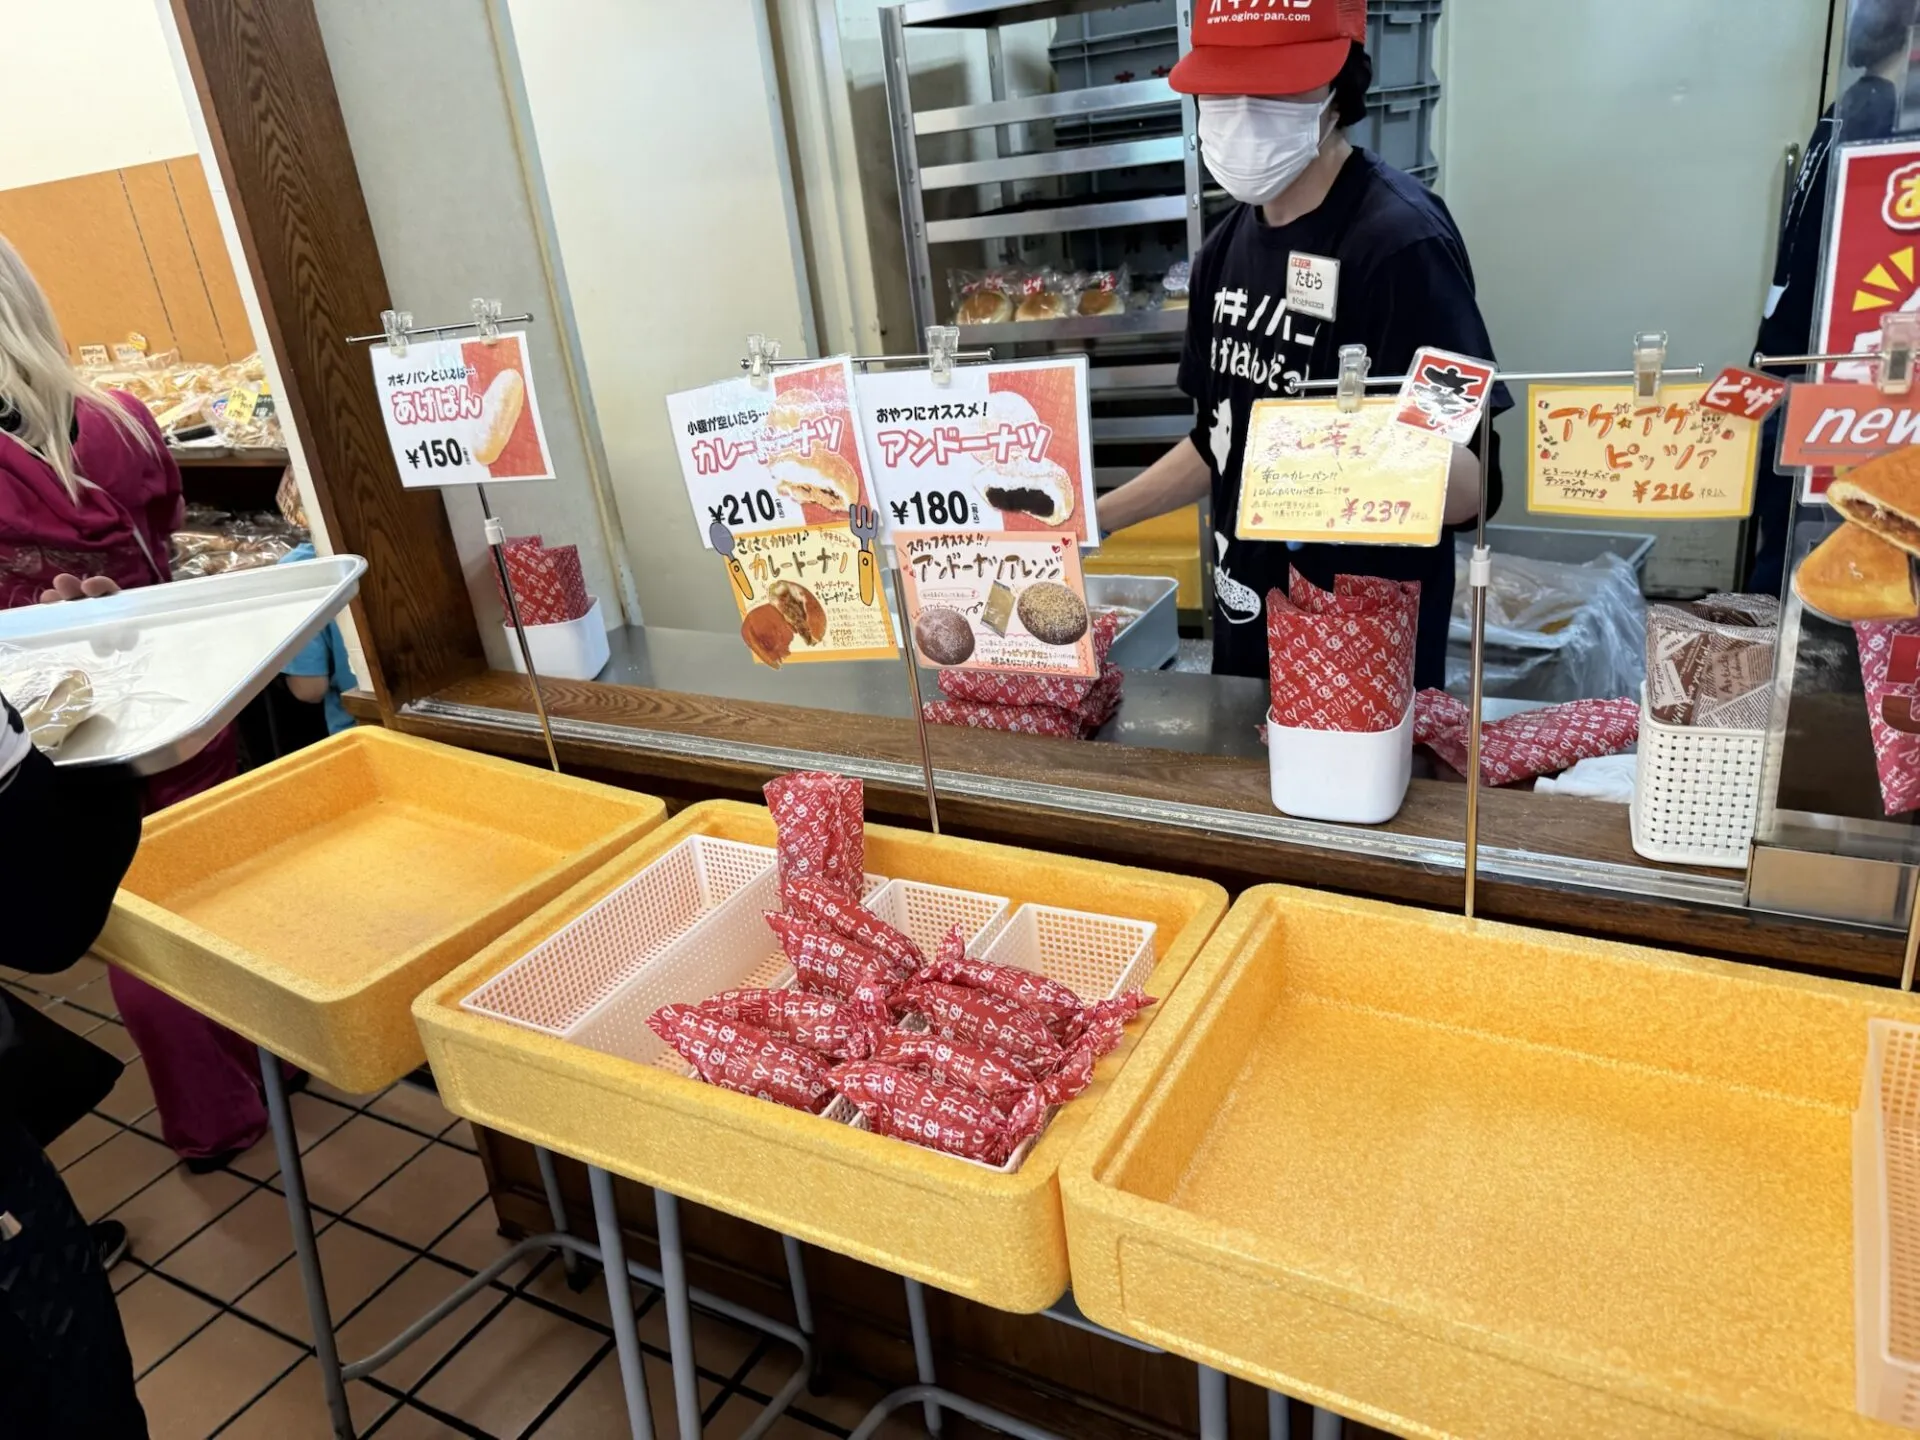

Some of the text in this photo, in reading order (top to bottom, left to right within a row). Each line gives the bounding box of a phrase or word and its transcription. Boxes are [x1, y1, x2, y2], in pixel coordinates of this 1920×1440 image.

[1295, 271, 1323, 290] たむら
[391, 385, 483, 425] あげぱん
[1705, 376, 1784, 415] ピザ
[405, 438, 463, 469] ¥150
[877, 422, 1053, 468] アンドーナツ
[1605, 442, 1717, 472] ピッツァ
[708, 489, 776, 526] ¥210
[890, 490, 969, 525] ¥180
[1632, 480, 1695, 504] ¥216
[1341, 497, 1412, 525] ¥237
[749, 547, 849, 581] カレードーナツ
